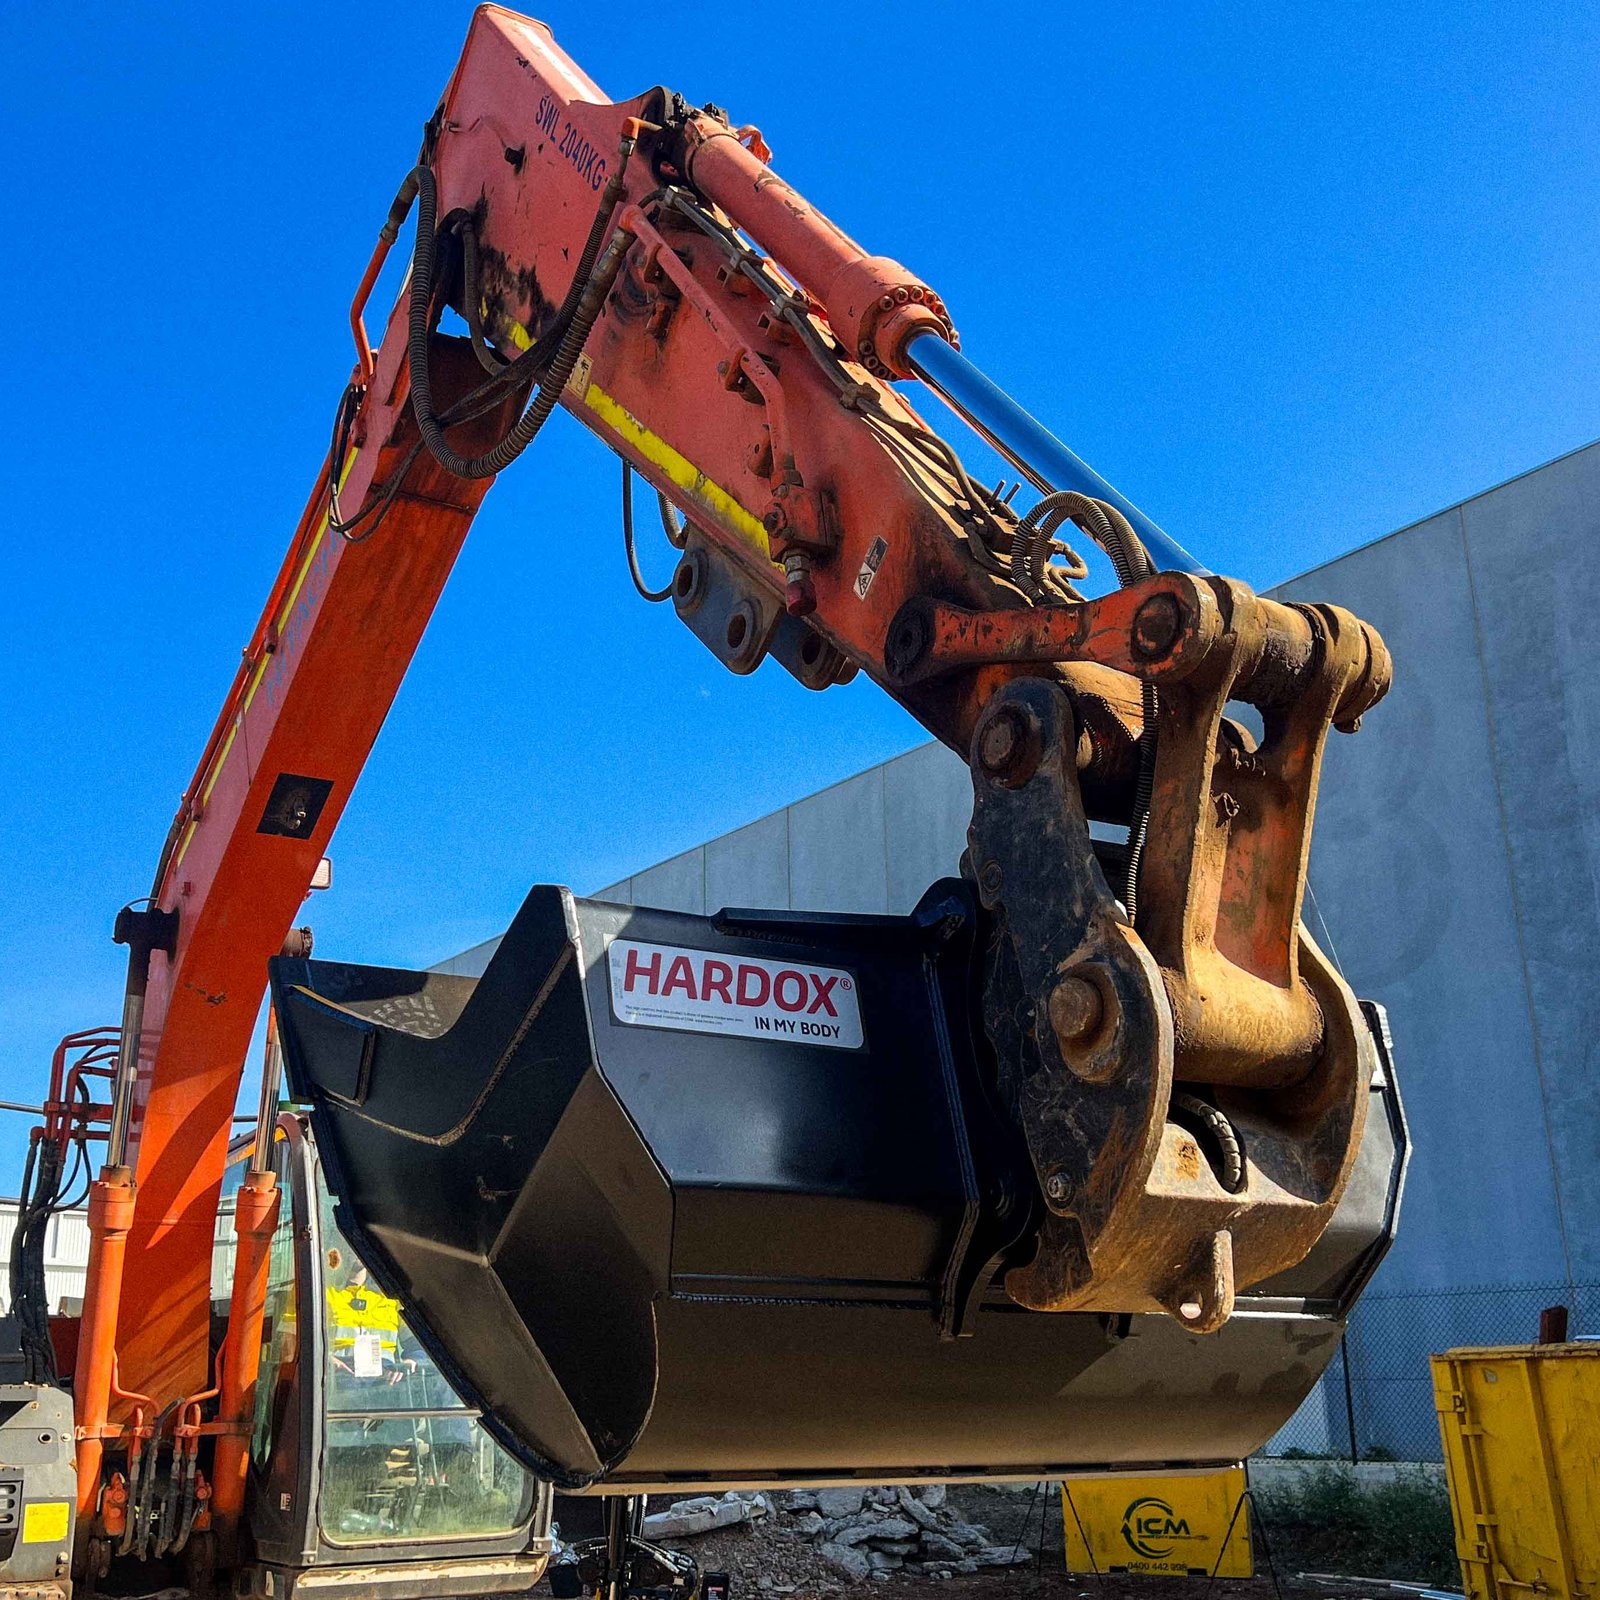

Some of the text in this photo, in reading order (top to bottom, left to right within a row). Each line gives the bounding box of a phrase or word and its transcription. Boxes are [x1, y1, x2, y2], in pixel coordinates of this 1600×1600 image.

[535, 97, 607, 191] SWL 2040KG
[754, 1015, 841, 1039] IN MY BODY
[1136, 1517, 1191, 1535] ICM
